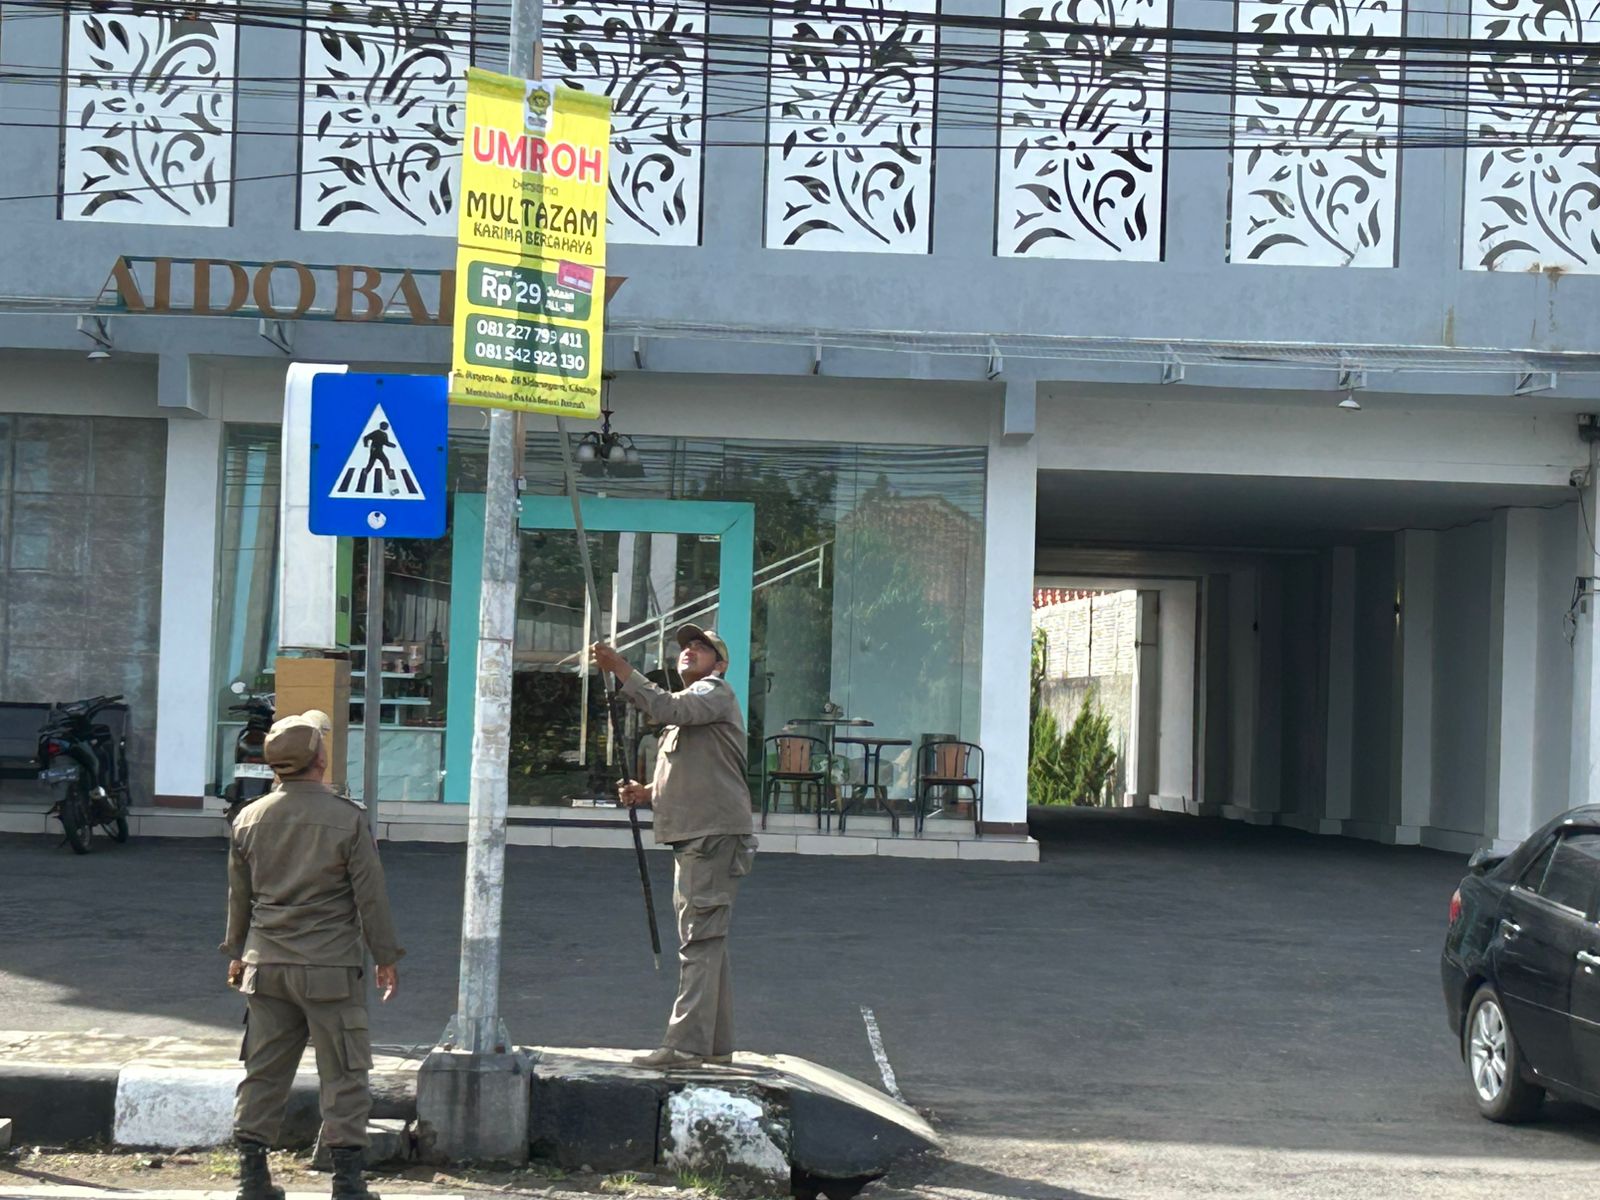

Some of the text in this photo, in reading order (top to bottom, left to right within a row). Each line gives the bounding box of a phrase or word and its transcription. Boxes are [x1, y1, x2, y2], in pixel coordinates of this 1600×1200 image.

[473, 127, 602, 183] UMROH
[466, 190, 598, 237] MULTAZAM
[474, 222, 593, 256] KARIMA BERCAHAYA
[96, 255, 316, 320] AIDO
[481, 274, 512, 307] Rp
[515, 281, 542, 305] 29
[476, 318, 583, 349] 081 227 799 411
[475, 342, 585, 371] 081 542 922 130
